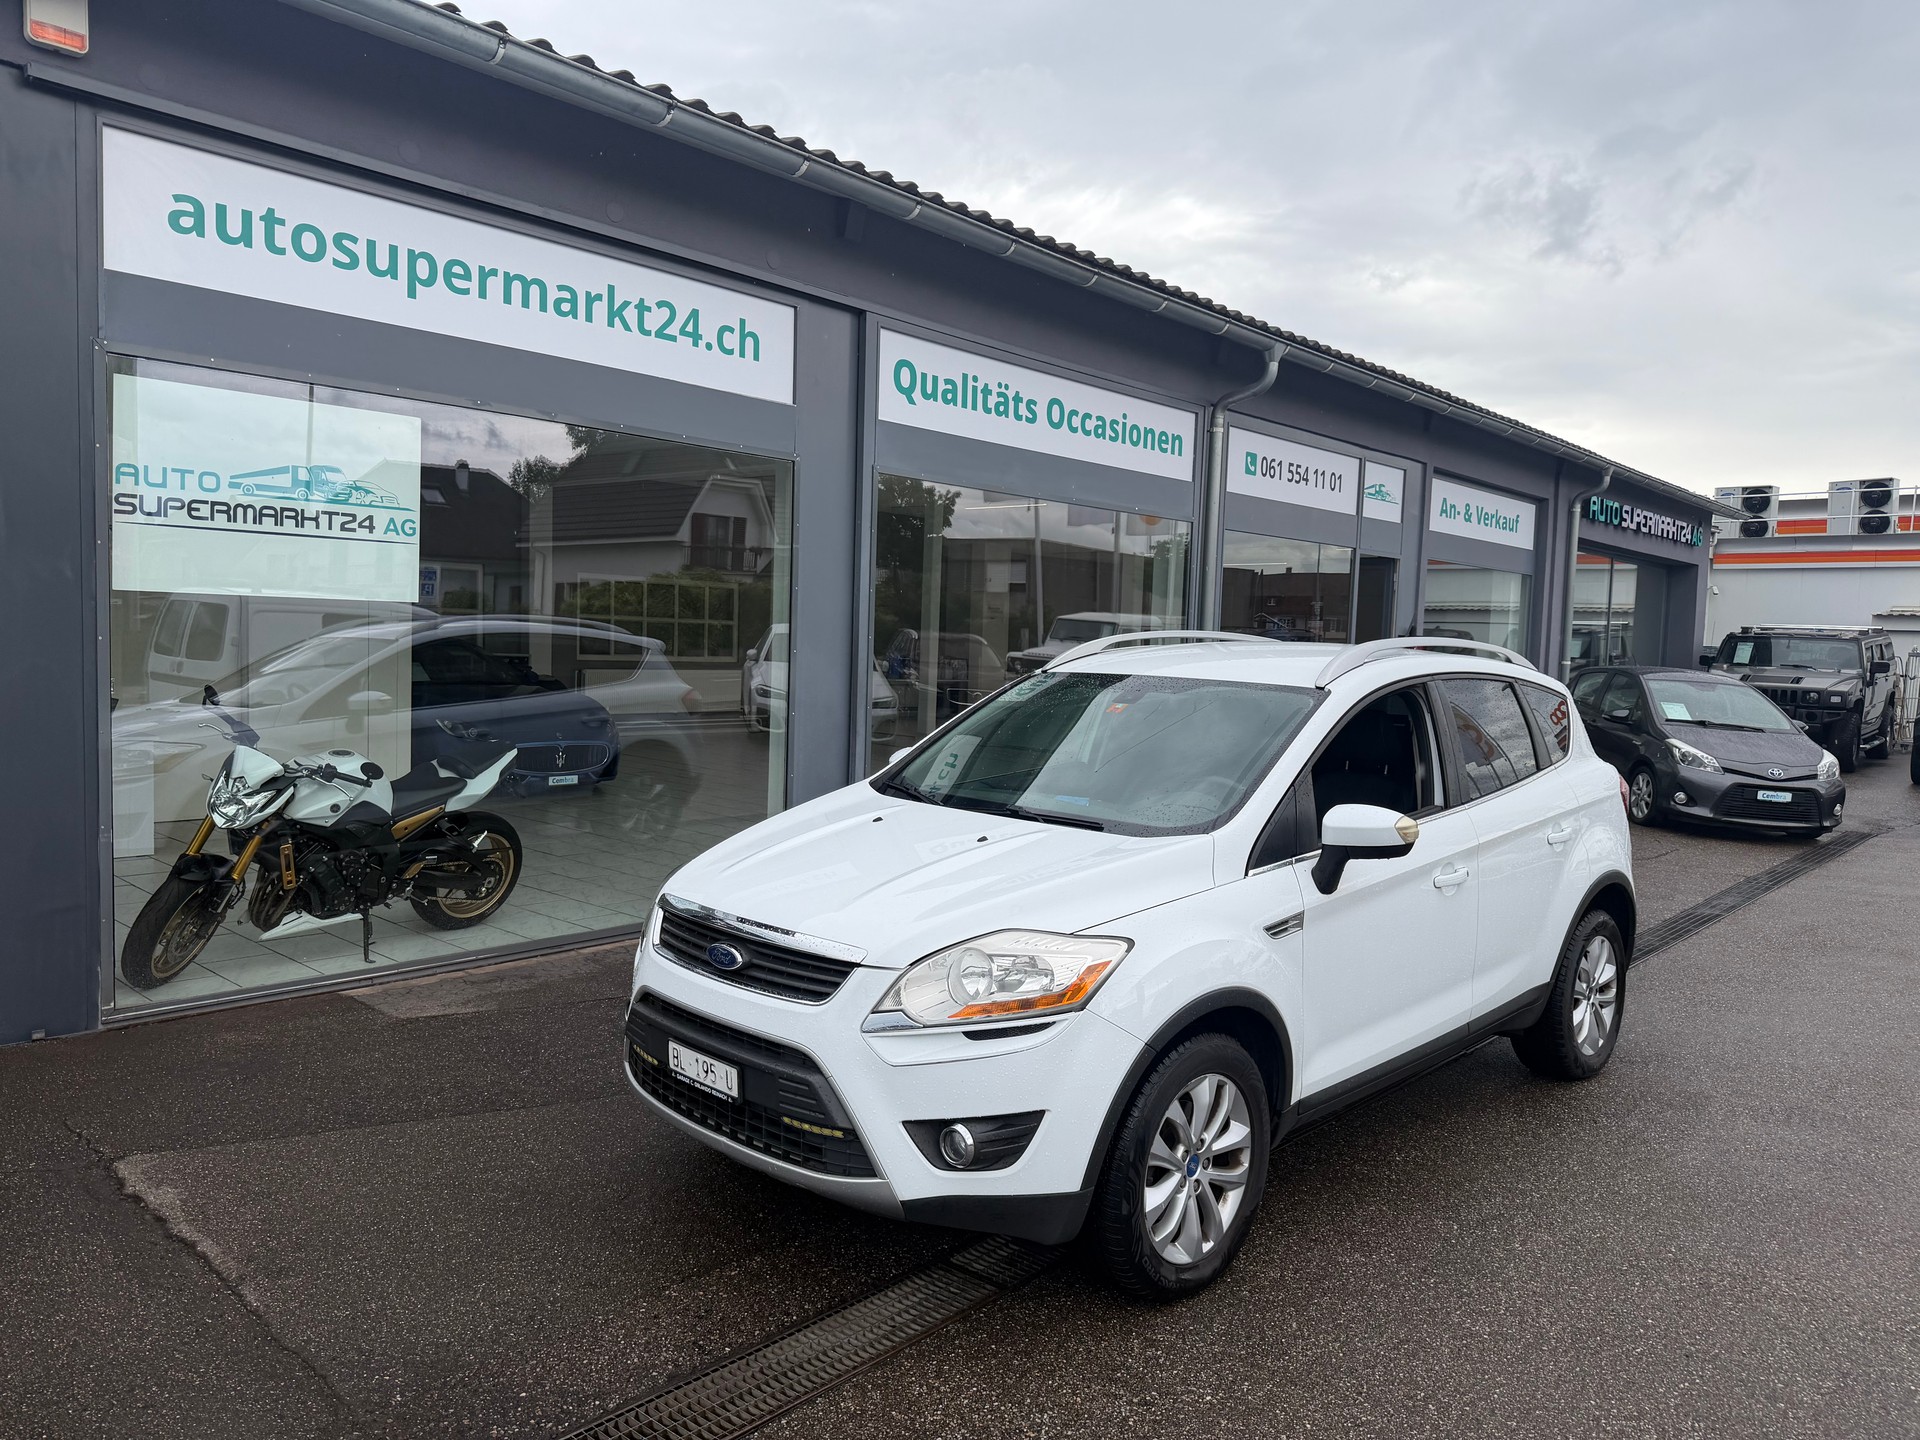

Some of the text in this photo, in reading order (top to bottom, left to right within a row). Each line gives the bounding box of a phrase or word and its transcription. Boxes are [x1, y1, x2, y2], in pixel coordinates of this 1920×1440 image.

[167, 193, 761, 362] autosupermarkt24.ch
[893, 358, 1184, 457] Qualitäts Occasionen
[114, 462, 221, 493] AUTO
[1261, 456, 1342, 493] 061 554 11 01
[113, 493, 417, 537] SUPERMARKT24 AG
[1439, 497, 1520, 533] An- & Verkauf
[1589, 495, 1704, 547] AUTO SUPERMARKT24 AG
[1761, 792, 1787, 800] Cembra
[695, 1056, 717, 1083] 195
